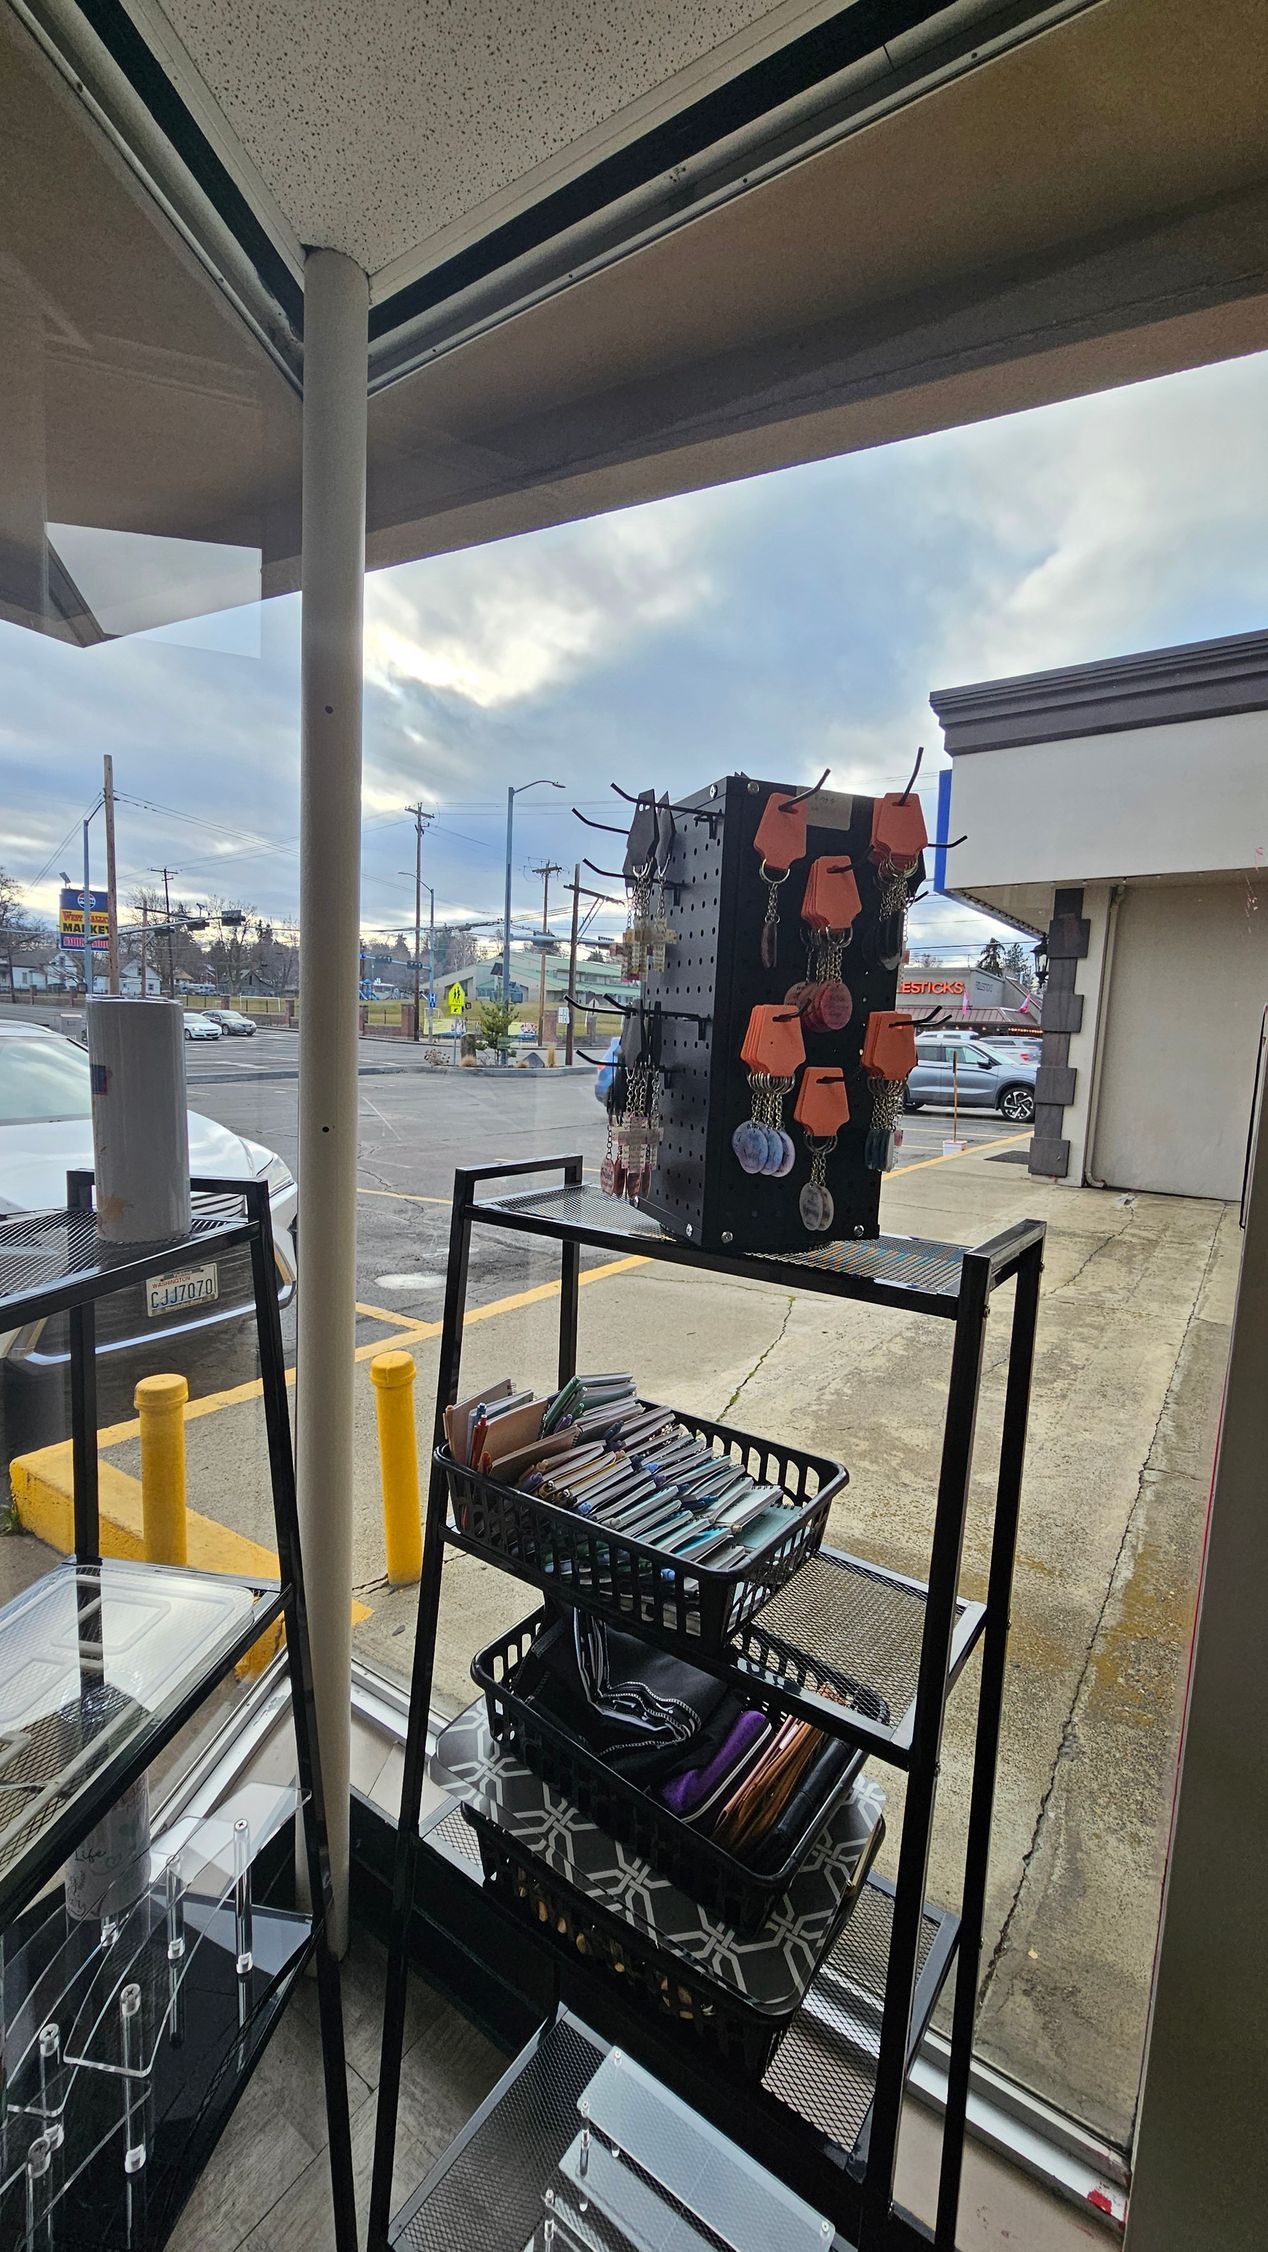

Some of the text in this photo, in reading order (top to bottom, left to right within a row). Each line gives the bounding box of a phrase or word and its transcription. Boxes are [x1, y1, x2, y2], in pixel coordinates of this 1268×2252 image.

[152, 1276, 191, 1288] WASHINGTON
[151, 1279, 213, 1308] CJJ7070
[75, 1848, 106, 1863] Life
